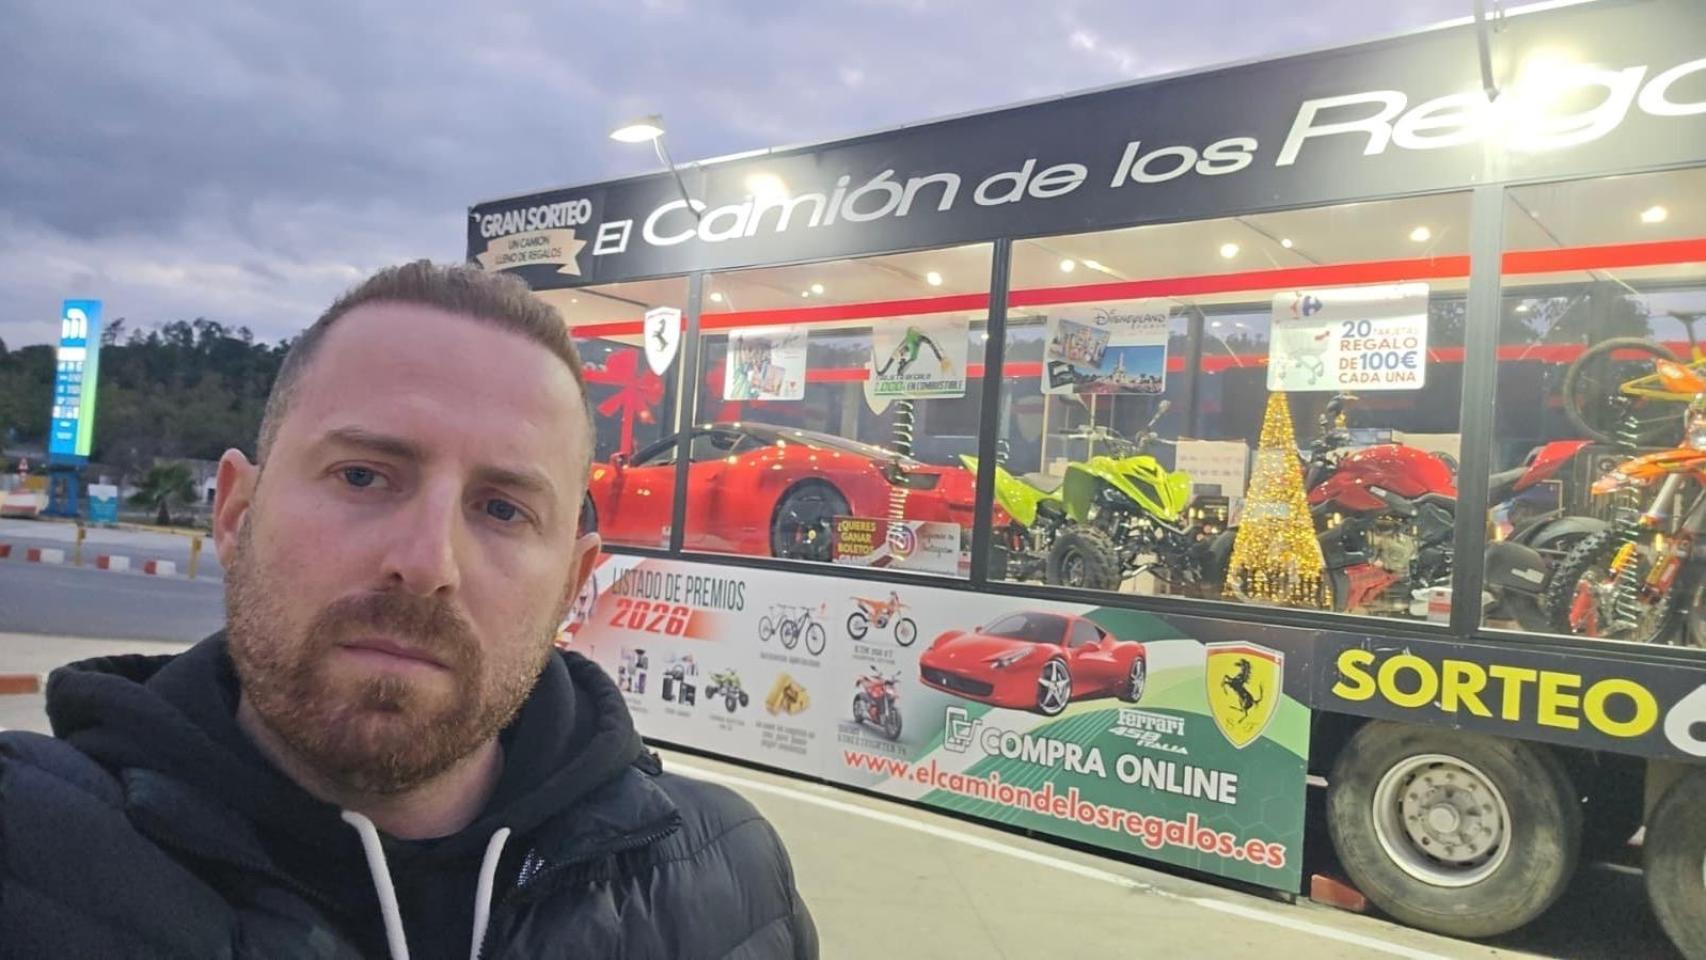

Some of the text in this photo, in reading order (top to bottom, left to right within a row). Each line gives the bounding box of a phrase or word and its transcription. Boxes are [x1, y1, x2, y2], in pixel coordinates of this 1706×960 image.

[642, 169, 961, 246] Camión
[973, 159, 1088, 206] de
[1110, 137, 1258, 187] los
[480, 199, 592, 238] GRAN SORTEO
[1340, 337, 1418, 351] REGALO
[1341, 320, 1372, 338] 20
[1338, 371, 1417, 384] CADA UNA
[1339, 351, 1418, 370] DE 100€
[611, 566, 746, 612] LISTADO DE PREMIOS
[609, 598, 690, 636] 2026
[1331, 649, 1658, 738] SORTEO
[1108, 726, 1163, 742] 458
[1117, 708, 1185, 736] Ferrari
[981, 727, 1238, 804] COMPRA ONLINE
[844, 750, 1285, 867] www.elcamiondelosregalos.es
